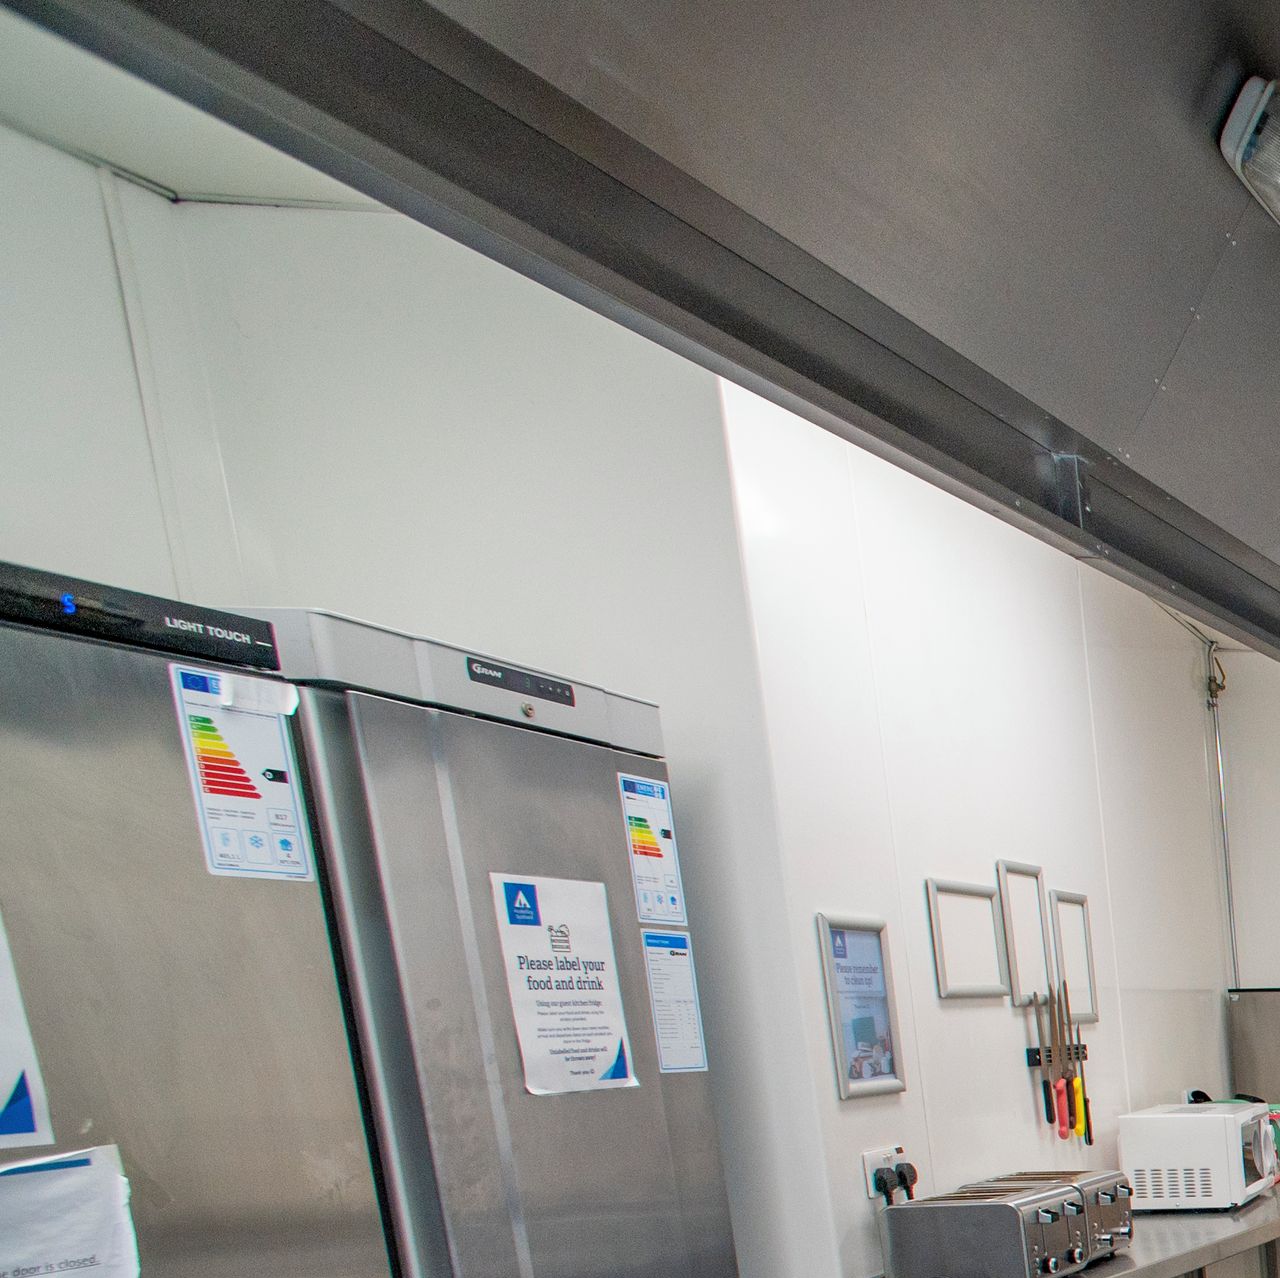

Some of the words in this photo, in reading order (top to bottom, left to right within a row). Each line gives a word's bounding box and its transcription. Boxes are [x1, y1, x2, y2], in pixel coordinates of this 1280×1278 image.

[165, 616, 205, 635] LIGHT
[206, 625, 252, 644] TOUCH
[517, 955, 554, 971] Please
[555, 956, 581, 971] label
[582, 960, 605, 974] your
[527, 975, 553, 990] food
[555, 975, 575, 990] and
[576, 976, 605, 990] drink
[12, 1265, 42, 1276] door
[45, 1263, 55, 1272] is
